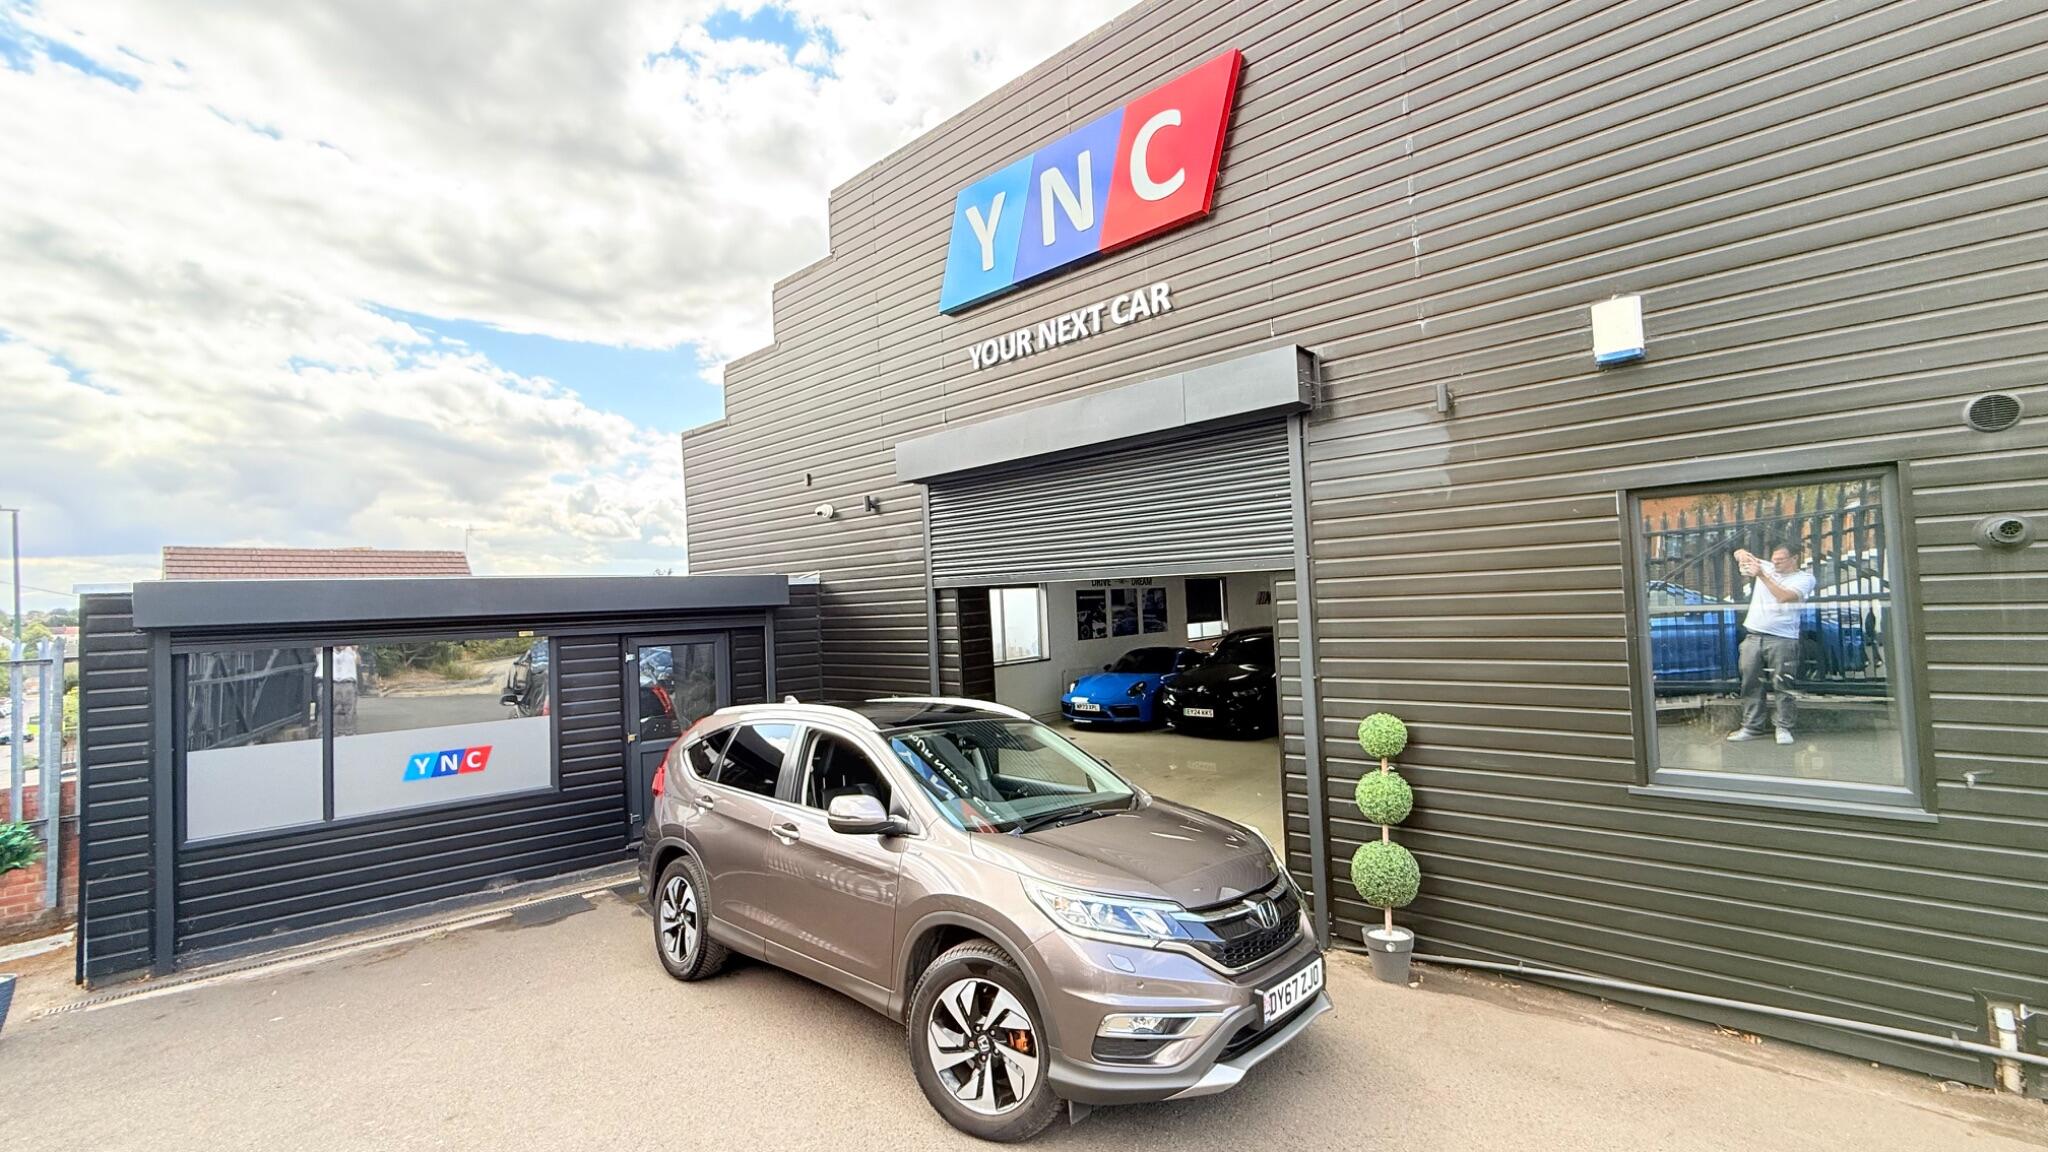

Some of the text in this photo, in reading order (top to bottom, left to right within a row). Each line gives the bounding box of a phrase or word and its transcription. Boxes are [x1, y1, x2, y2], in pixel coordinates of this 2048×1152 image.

[965, 108, 1185, 272] YNC
[969, 282, 1173, 370] YOUR NEXT CAR
[413, 751, 482, 775] YNC
[1269, 964, 1319, 1016] DY67 ZJO
